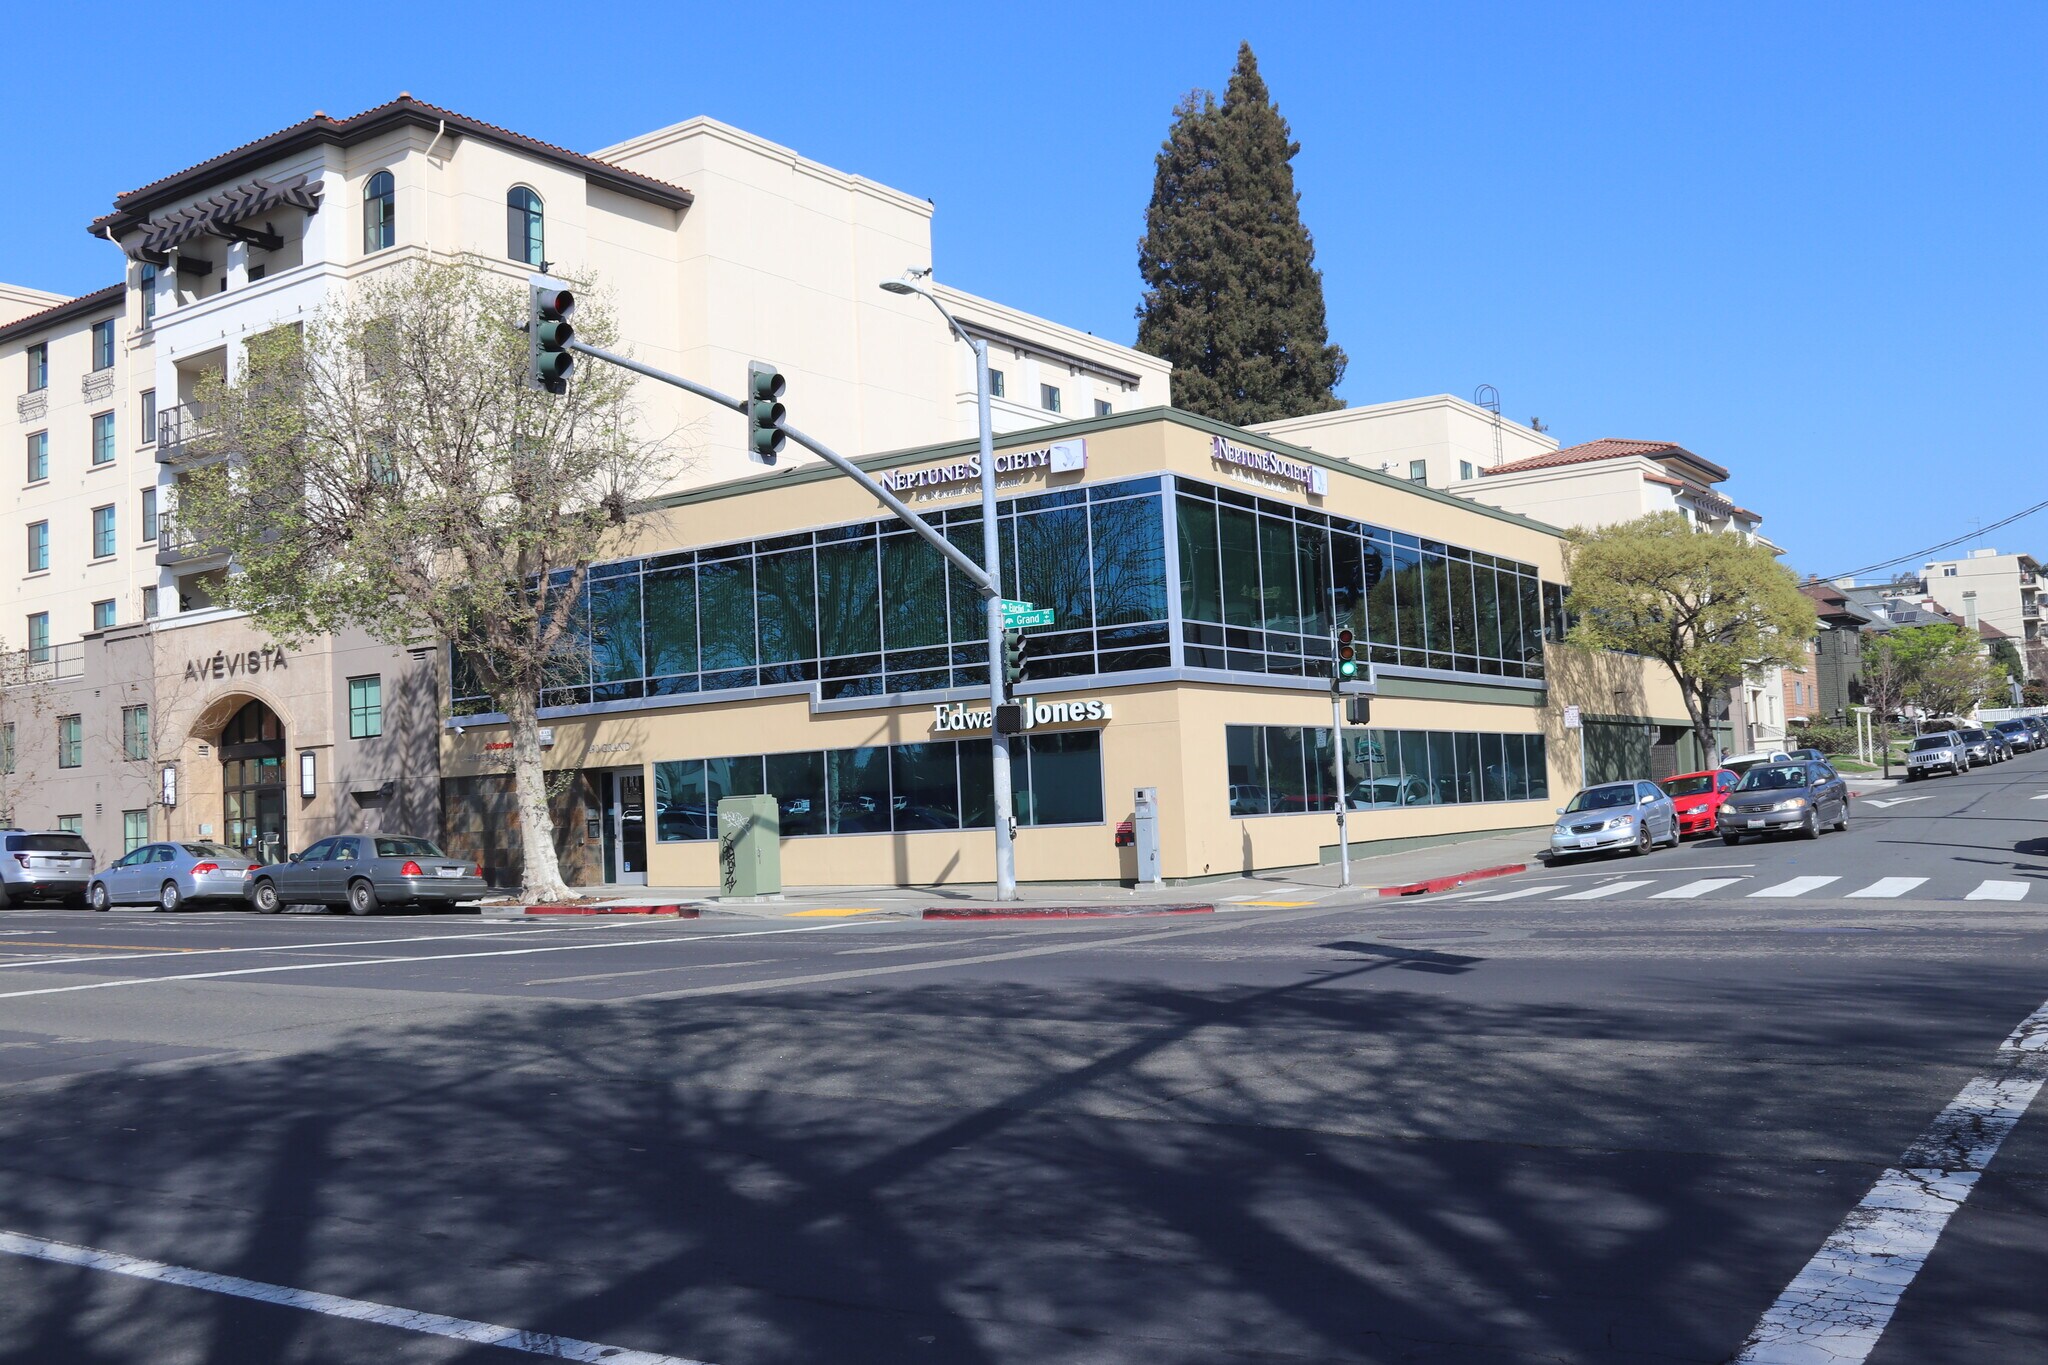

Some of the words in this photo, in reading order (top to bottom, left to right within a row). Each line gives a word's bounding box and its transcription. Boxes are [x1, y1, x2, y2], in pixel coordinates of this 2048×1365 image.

[880, 464, 966, 491] NEPTUNE
[968, 449, 1050, 479] SCIETY
[1217, 436, 1270, 471] NEPTUNE
[1269, 452, 1312, 483] SOCIETY
[1016, 614, 1040, 625] Grand
[184, 644, 288, 683] AVÉVISTA
[933, 699, 1019, 732] Edwa
[1025, 697, 1103, 730] Jones
